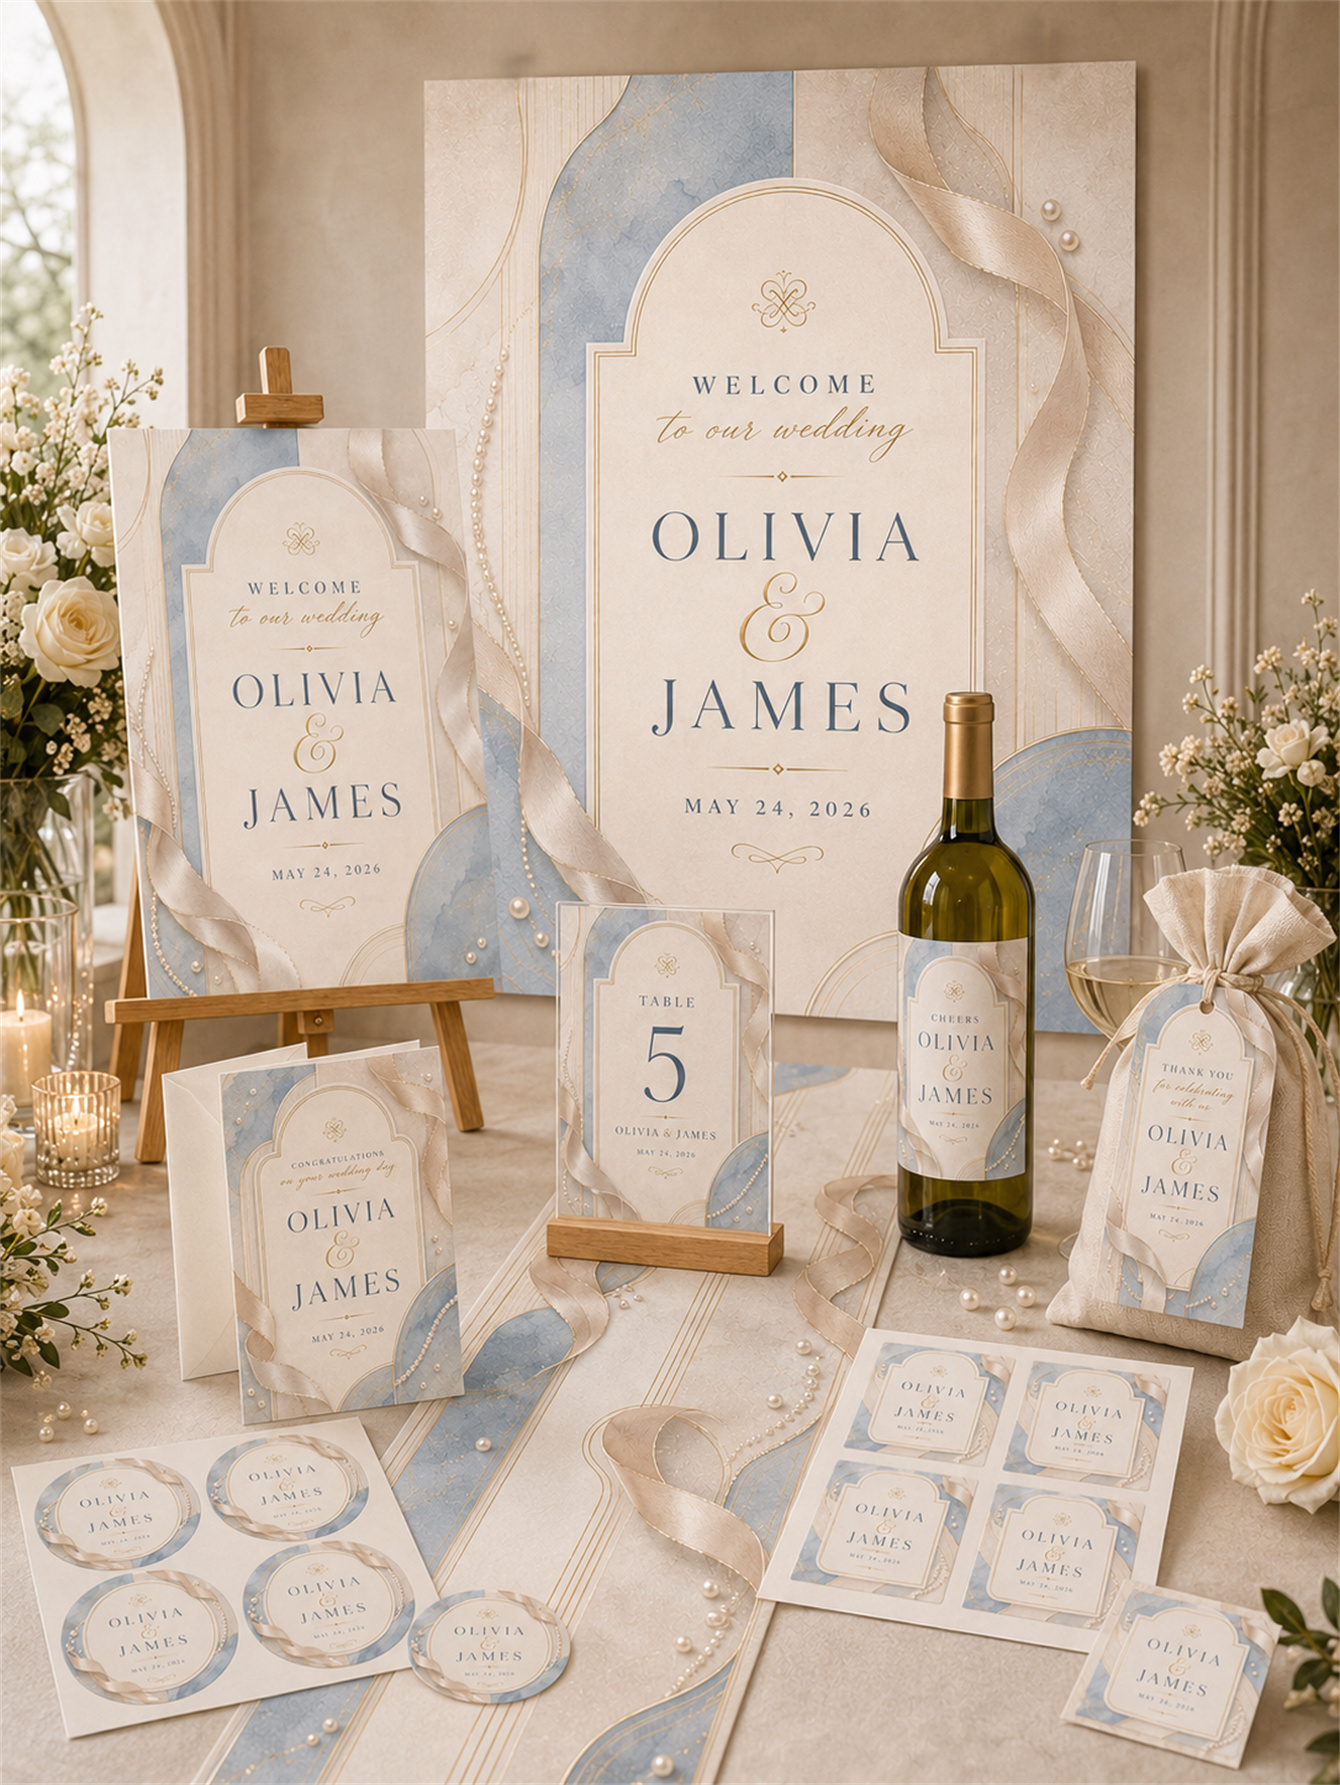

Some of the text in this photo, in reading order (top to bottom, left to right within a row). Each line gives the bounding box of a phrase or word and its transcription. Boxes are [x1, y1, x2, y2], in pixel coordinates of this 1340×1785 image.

[693, 374, 876, 396] WELCOME
[657, 406, 913, 462] to our wedding
[653, 512, 919, 561] OLIVIA
[247, 580, 361, 596] WELCOME
[228, 601, 384, 638] to our wedding
[739, 572, 825, 662] &
[233, 671, 395, 708] OLIVIA
[652, 679, 909, 736] JAMES
[293, 714, 344, 773] &
[244, 783, 401, 829] JAMES
[684, 798, 872, 818] MAY 24, 2026
[272, 863, 381, 881] MAY 24, 2026
[639, 995, 695, 1009] TABLE
[931, 1013, 979, 1024] CHEERS
[918, 1031, 994, 1051] OLIVIA
[644, 1026, 685, 1102] 5
[942, 1054, 968, 1082] &
[1162, 1063, 1233, 1080] THANK YOU
[918, 1084, 992, 1105] JAMES
[615, 1126, 717, 1140] OLIVIA & JAMES
[1148, 1124, 1227, 1151] OLIVIA
[291, 1150, 385, 1169] CONGRATULATIONS
[637, 1148, 655, 1156] MAY
[1171, 1149, 1197, 1176] &
[328, 1164, 371, 1182] wedding
[1141, 1175, 1219, 1202] JAMES
[288, 1198, 394, 1232] OLIVIA
[326, 1231, 360, 1269] &
[292, 1269, 399, 1311] JAMES
[312, 1325, 385, 1344] MAY 24, 2026
[901, 1381, 966, 1398] OLIVIA
[894, 1406, 955, 1423] JAMES
[1055, 1401, 1122, 1419] OLIVIA
[1051, 1427, 1113, 1445] JAMES
[249, 1465, 316, 1482] OLIVIA
[79, 1490, 150, 1508] OLIVIA
[261, 1487, 323, 1506] JAMES
[88, 1513, 153, 1534] JAMES
[855, 1503, 924, 1523] OLIVIA
[846, 1531, 912, 1551] JAMES
[1021, 1529, 1093, 1550] OLIVIA
[1016, 1558, 1083, 1578] JAMES
[287, 1576, 361, 1597] OLIVIA
[108, 1607, 183, 1629] OLIVIA
[300, 1602, 367, 1625] JAMES
[454, 1626, 524, 1636] OLIVIA
[119, 1634, 188, 1657] JAMES
[1147, 1638, 1220, 1666] OLIVIA
[456, 1651, 523, 1662] JAMES
[1136, 1669, 1208, 1697] JAMES
